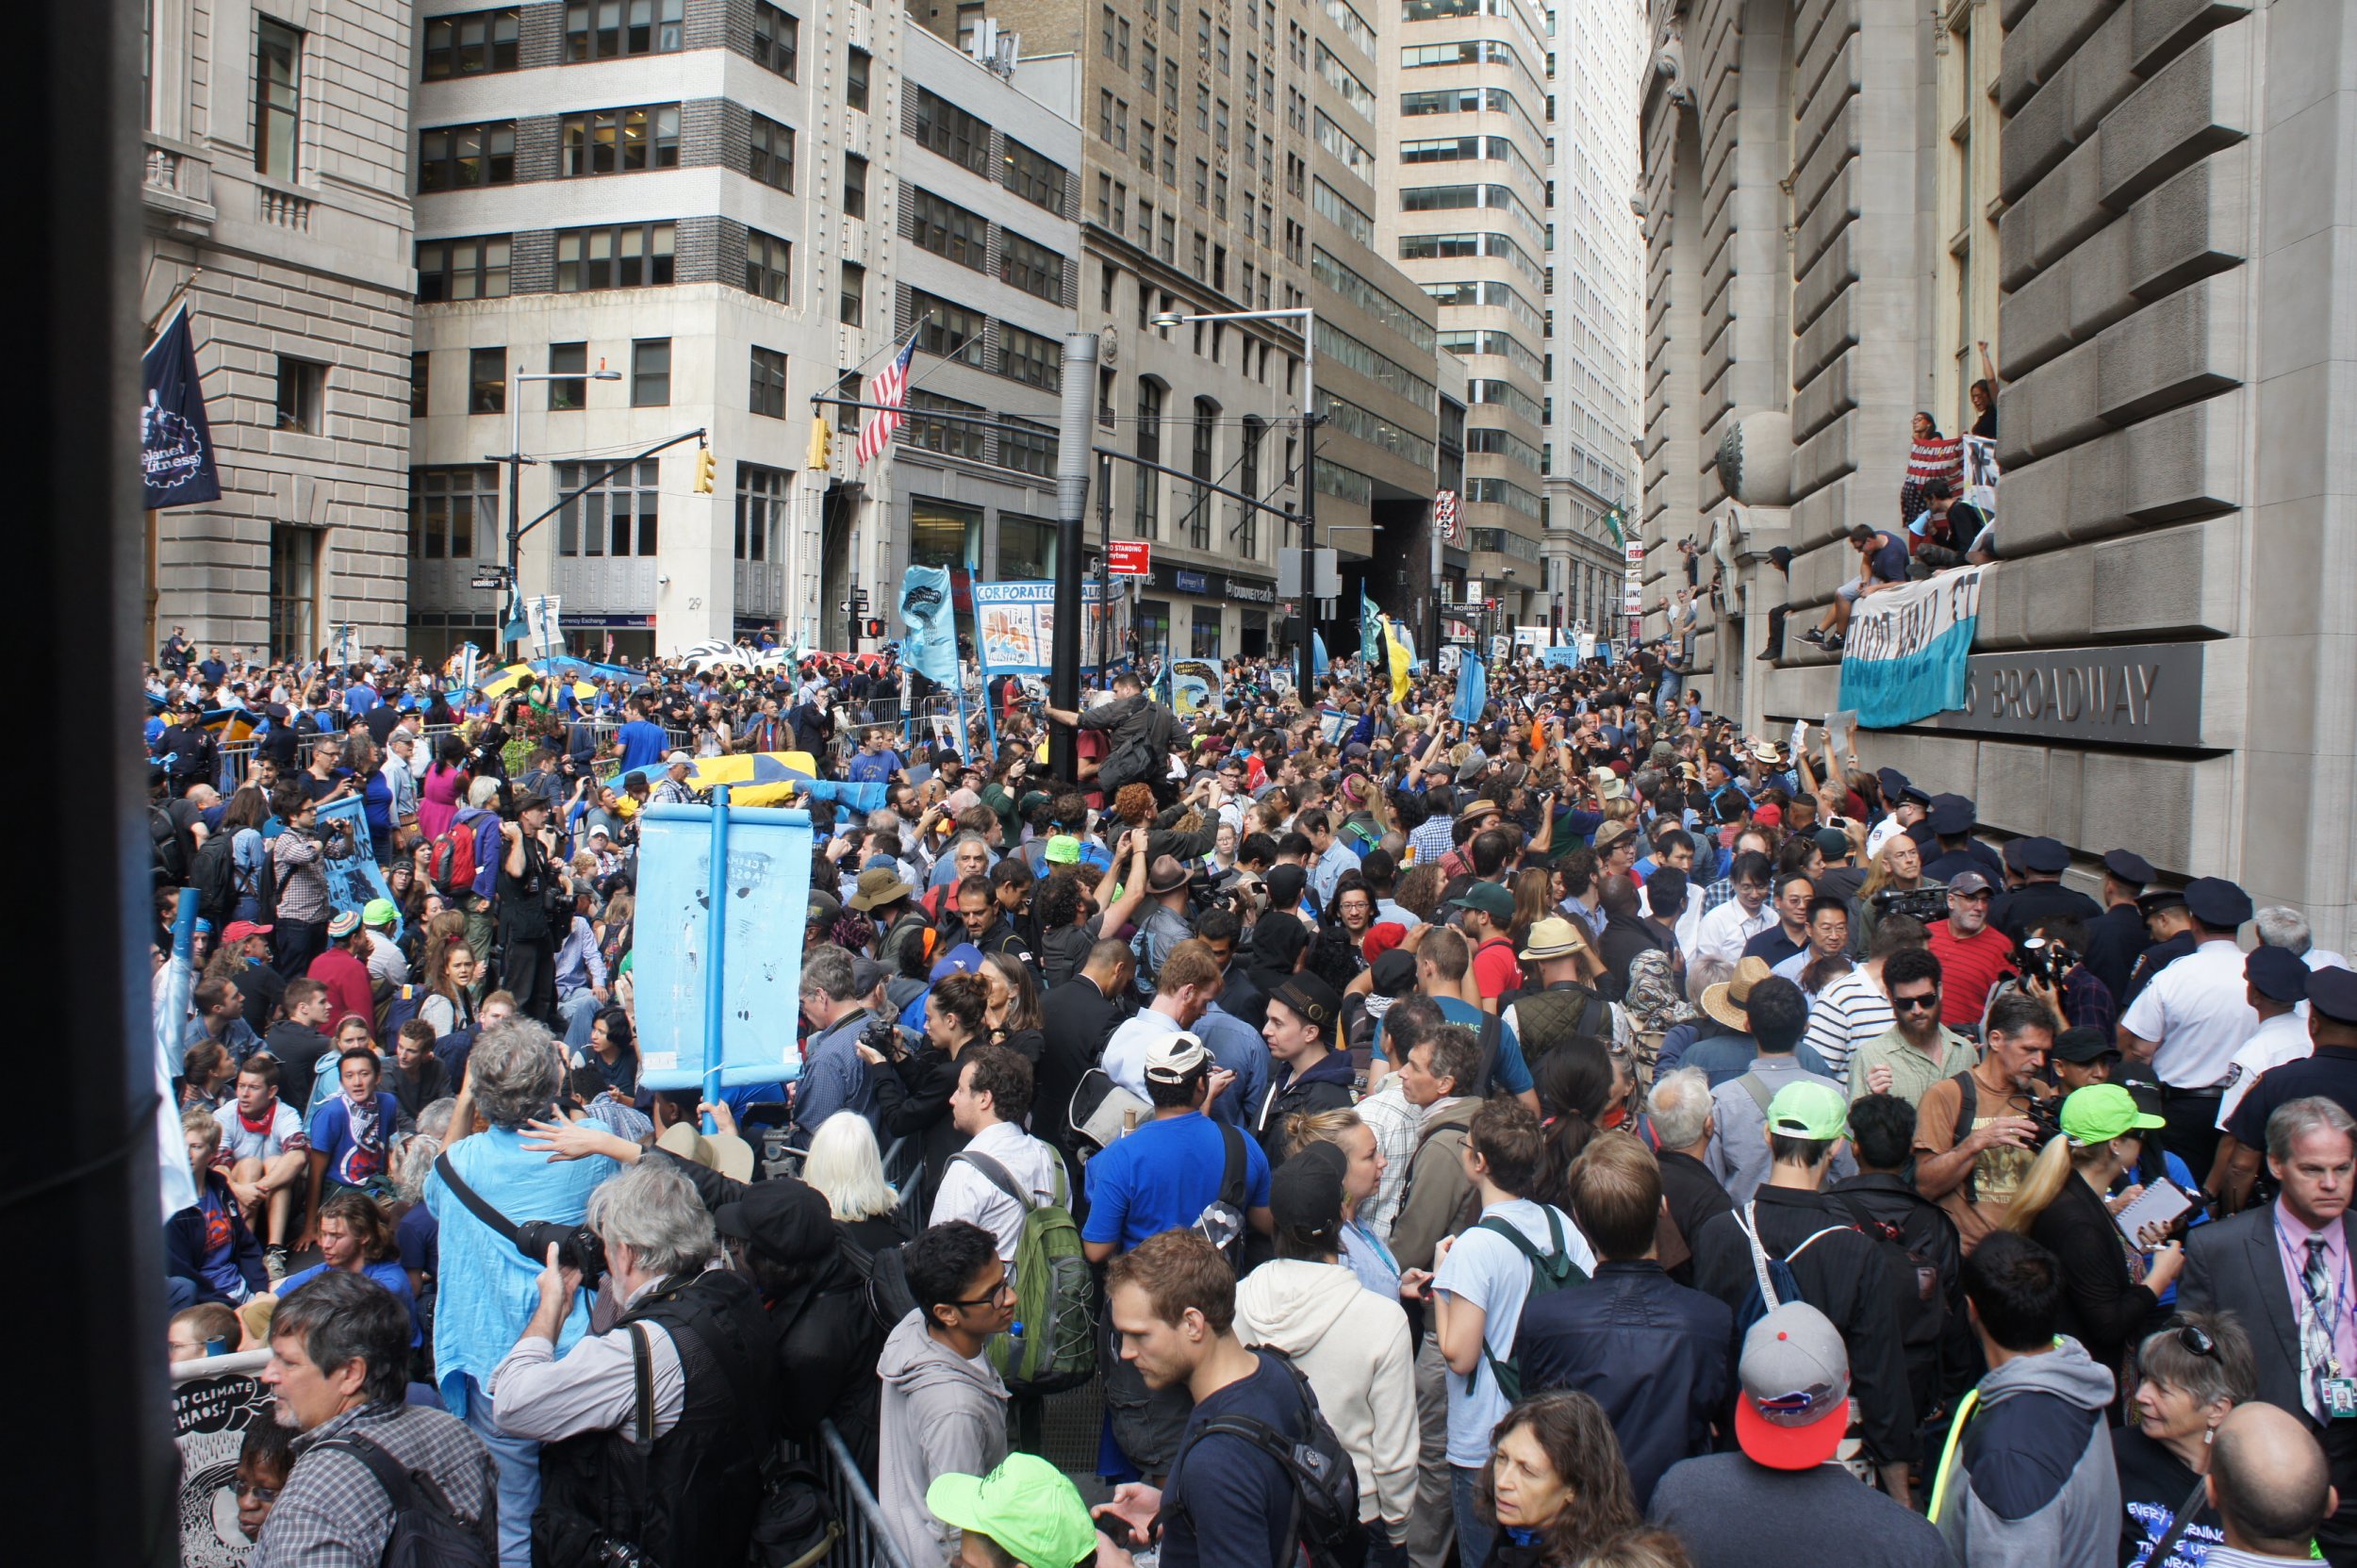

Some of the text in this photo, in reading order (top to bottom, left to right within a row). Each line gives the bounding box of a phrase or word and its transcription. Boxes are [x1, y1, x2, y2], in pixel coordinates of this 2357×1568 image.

[978, 586, 1049, 600] CORPORATE
[688, 598, 702, 610] 29
[582, 617, 606, 625] Exchange
[1992, 664, 2160, 725] BROADWAY
[191, 1382, 253, 1404] CLIMATE
[173, 1400, 226, 1430] HAOS!
[2127, 1501, 2167, 1526] EVERY
[2136, 1541, 2154, 1555] TH
